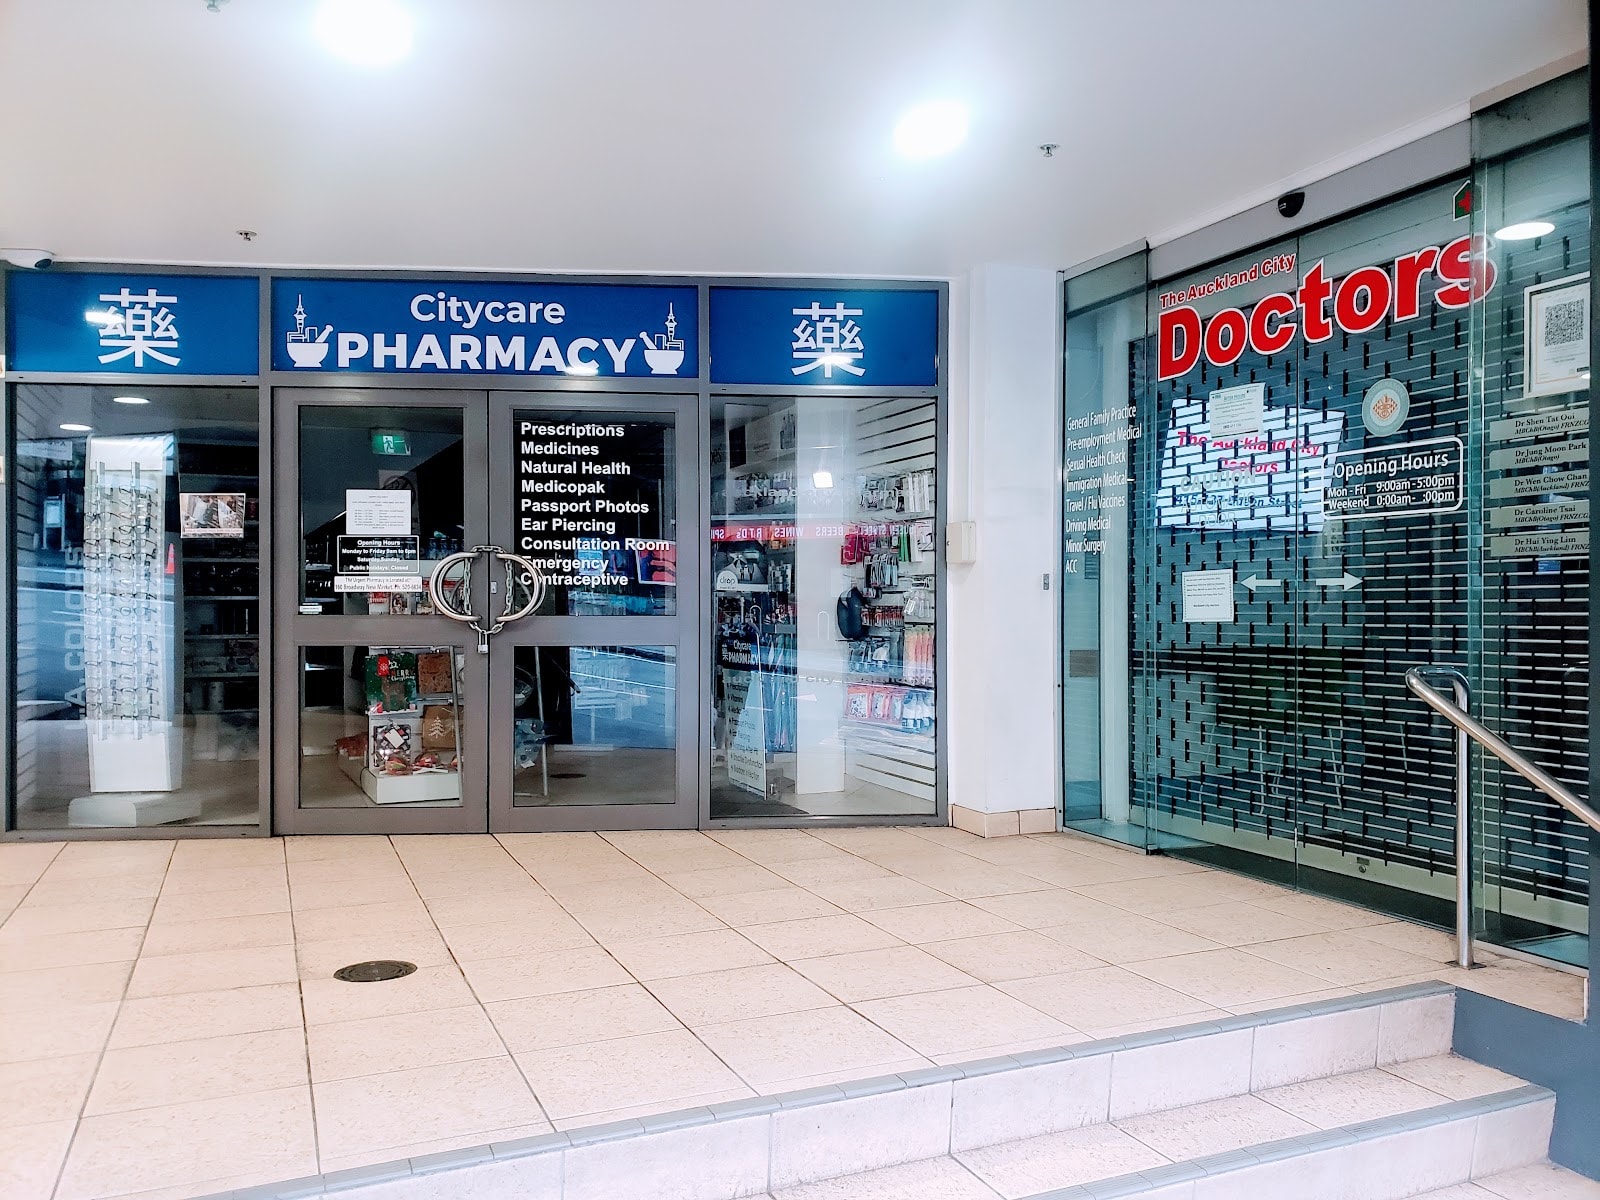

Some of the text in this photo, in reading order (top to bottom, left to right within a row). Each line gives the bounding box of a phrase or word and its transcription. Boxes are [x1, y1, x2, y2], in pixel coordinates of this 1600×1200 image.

[1160, 253, 1297, 309] The Auckland City
[410, 291, 567, 329] Citycare
[1158, 233, 1498, 382] Doctors
[97, 287, 182, 368] 藥
[791, 302, 866, 378] 藥
[337, 332, 637, 376] PHARMACY
[1067, 403, 1137, 431] General Family Practice
[1515, 419, 1524, 428] Dr
[1525, 418, 1545, 427] Shen
[1546, 415, 1559, 424] Tat
[521, 422, 625, 439] Prescriptions
[1067, 423, 1142, 452] Pre-employment Medical
[1177, 431, 1208, 447] The
[521, 441, 600, 456] Medicines
[1515, 443, 1587, 459] Dr Jung Moon Park
[521, 460, 631, 475] Natural Health
[1066, 451, 1126, 472] Sexual Health Check
[1334, 453, 1450, 481] Opening Hours
[521, 479, 606, 497] Medicopak
[1066, 470, 1128, 495] Immigration Medical
[1180, 469, 1257, 492] CAUTION
[1514, 473, 1588, 487] Dr Wen Chow Chan
[1327, 487, 1348, 498] Mon
[1354, 484, 1367, 495] Fri
[521, 499, 650, 515] Passport Photos
[1065, 498, 1084, 513] Travel
[1088, 496, 1098, 510] Flu
[1098, 494, 1126, 508] Vaccines
[1328, 496, 1369, 510] Weekend
[1514, 504, 1576, 516] Dr Caroline Tsai
[521, 517, 616, 535] Ear Piercing
[1065, 514, 1111, 535] Driving Medical
[521, 537, 671, 551] Consultation Room
[1065, 537, 1107, 555] Minor Surgery
[1514, 535, 1577, 547] Dr Hui Ying Lim
[1065, 559, 1078, 573] ACC
[520, 573, 629, 589] Cntraceptive
